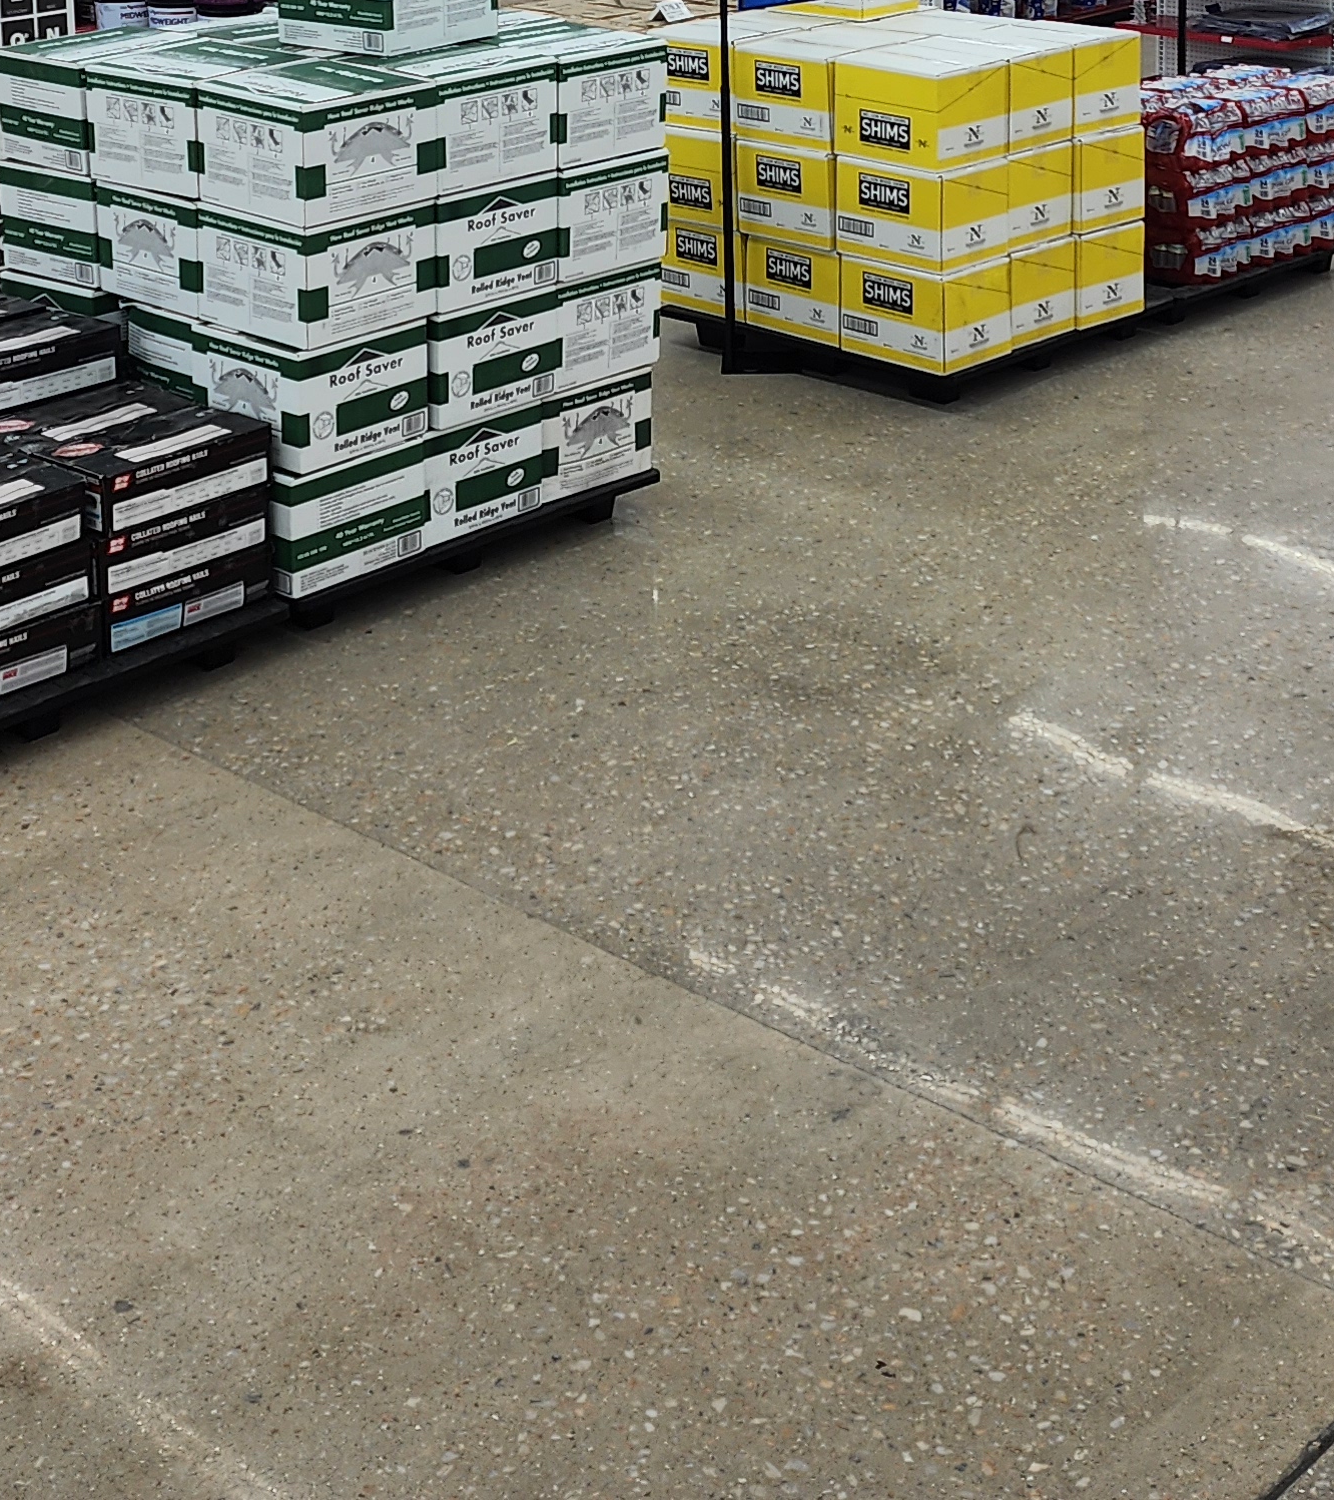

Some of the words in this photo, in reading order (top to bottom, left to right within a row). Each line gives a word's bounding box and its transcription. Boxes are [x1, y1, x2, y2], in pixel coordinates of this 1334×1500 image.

[667, 54, 708, 75] SHIMS
[757, 68, 799, 92] SHIMS
[861, 119, 909, 143] SHIMS
[758, 164, 799, 187] SHIMS
[671, 184, 710, 204] SHIMS
[861, 182, 908, 208] SHIMS
[467, 212, 496, 232] Roof
[500, 208, 536, 224] Saver
[677, 237, 716, 260] SHIMS
[768, 258, 810, 282] SHIMS
[471, 281, 494, 294] Rolled
[495, 276, 515, 288] Ridge
[517, 271, 532, 282] Vent
[864, 282, 911, 308] SHIMS
[467, 329, 496, 349] Roof
[499, 320, 535, 338] Saver
[329, 366, 361, 388] Roof
[365, 356, 404, 378] Saver
[470, 396, 493, 411] Rolled
[494, 391, 514, 405] Ridge
[515, 384, 531, 397] Vent
[334, 436, 358, 452] Rolled
[360, 430, 382, 444] Ridge
[383, 423, 400, 436] Vent
[449, 446, 480, 467] Roof
[483, 434, 521, 456] Saver
[454, 510, 478, 527] Rolled
[479, 504, 500, 521] Ridge
[500, 498, 517, 510] Vent
